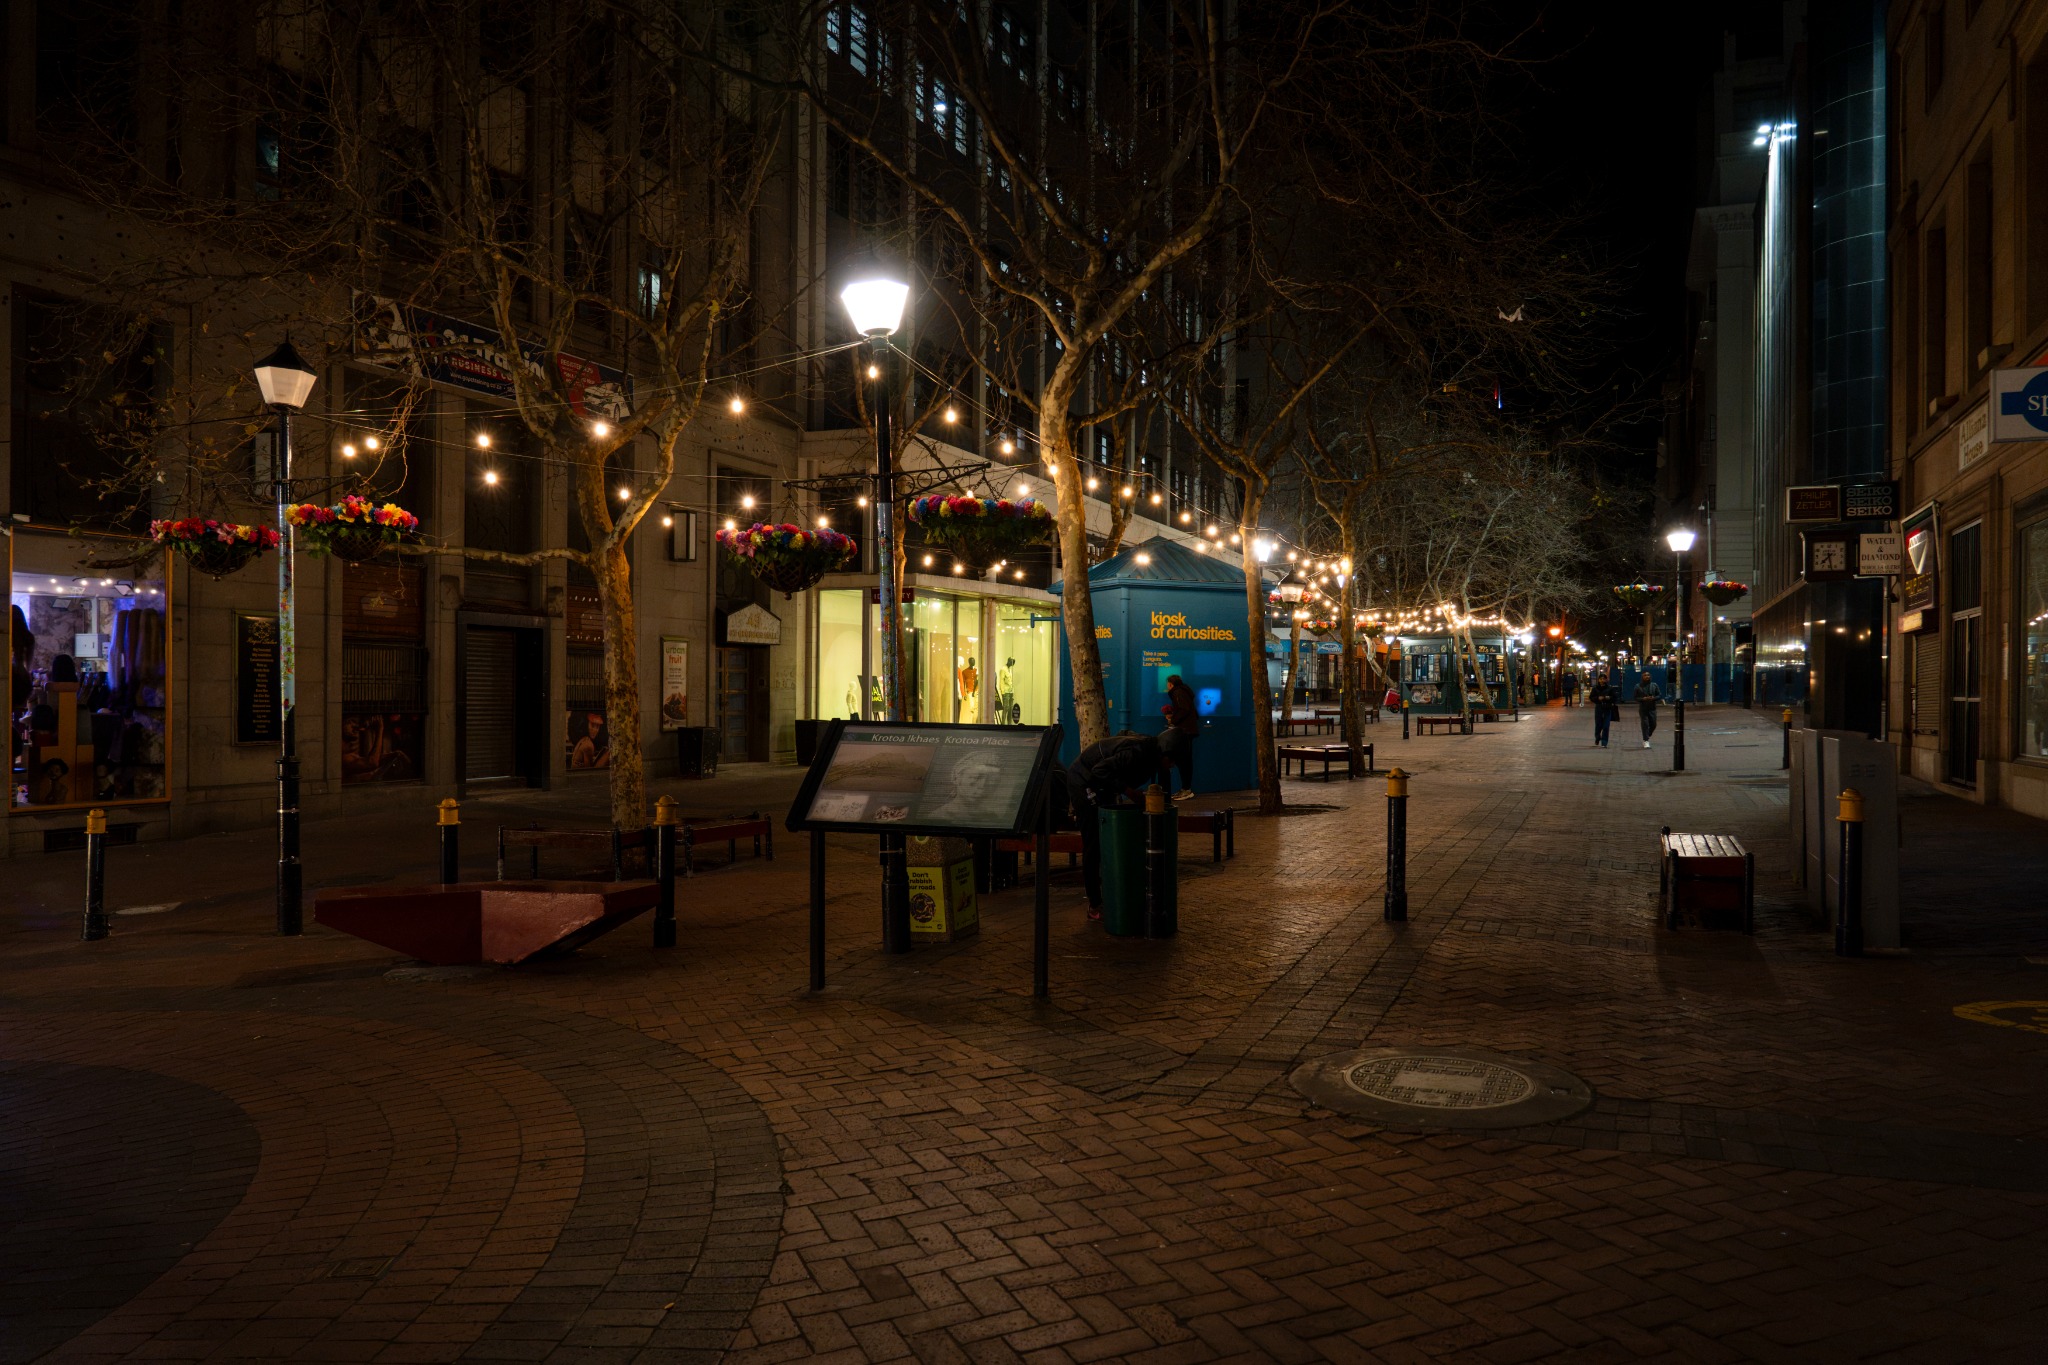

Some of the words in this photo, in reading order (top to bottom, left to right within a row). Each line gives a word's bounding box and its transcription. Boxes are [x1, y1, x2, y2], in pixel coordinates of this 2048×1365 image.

[1800, 490, 1828, 500] PHILIP
[1845, 485, 1893, 497] SEIKO
[1795, 500, 1832, 510] ZETLER
[1845, 496, 1893, 507] SEIKO
[1845, 505, 1893, 517] SEIKO
[1866, 537, 1895, 545] WATCH
[1861, 553, 1901, 561] DIAMOND
[1151, 611, 1187, 626] kiosk
[1151, 625, 1164, 639] of
[1166, 626, 1237, 641] curiosities.
[668, 655, 682, 664] fruit
[871, 733, 905, 743] Krotoa
[944, 735, 978, 745] Krotoa
[981, 736, 1010, 746] Place
